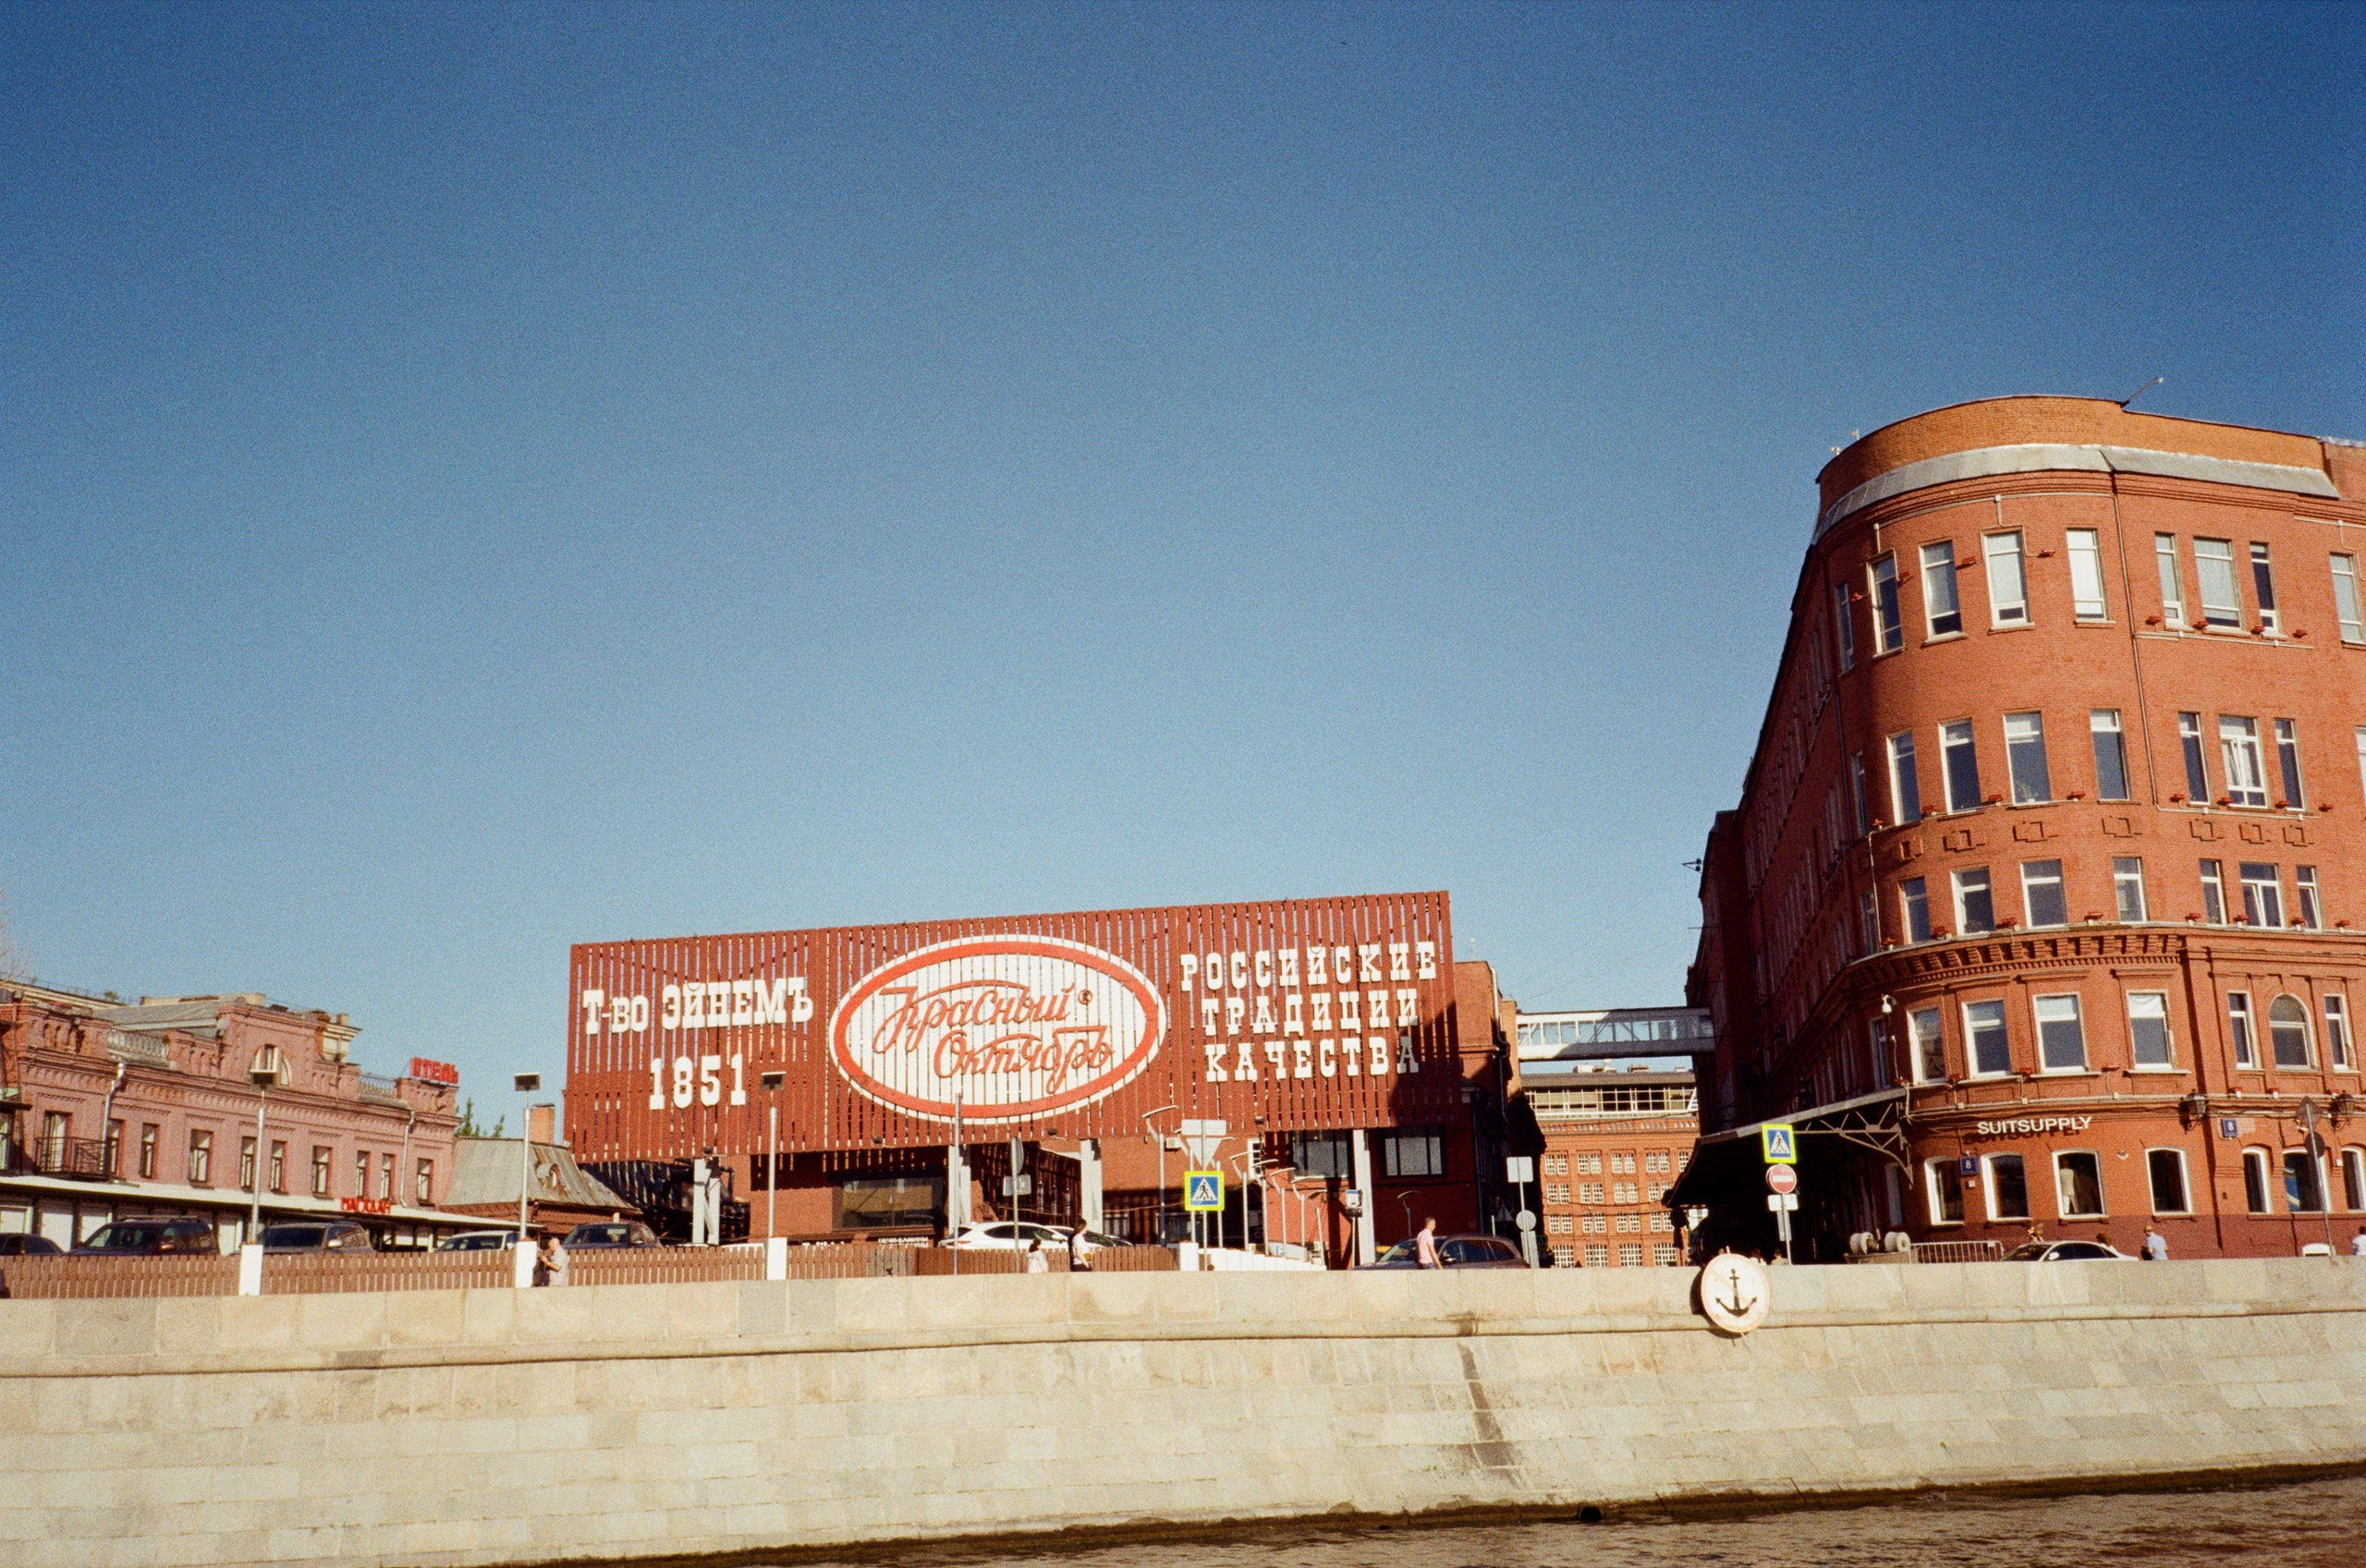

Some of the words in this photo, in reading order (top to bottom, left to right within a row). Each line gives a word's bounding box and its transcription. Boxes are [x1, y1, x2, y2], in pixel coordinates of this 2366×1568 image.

[1180, 941, 1436, 992] РОССИЙСКИЕ
[662, 976, 814, 1030] ЭЙНЕМЪ
[872, 979, 1075, 1054] Красный
[1201, 988, 1420, 1038] ТРАДИЦИИ
[649, 1053, 747, 1110] 1851
[933, 1025, 1116, 1094] Октябрь
[1205, 1036, 1420, 1083] КАЧЕСТВА
[1977, 1115, 2092, 1135] SUITSUPPLY
[2227, 1121, 2235, 1131] 8
[1965, 1160, 1971, 1169] 8
